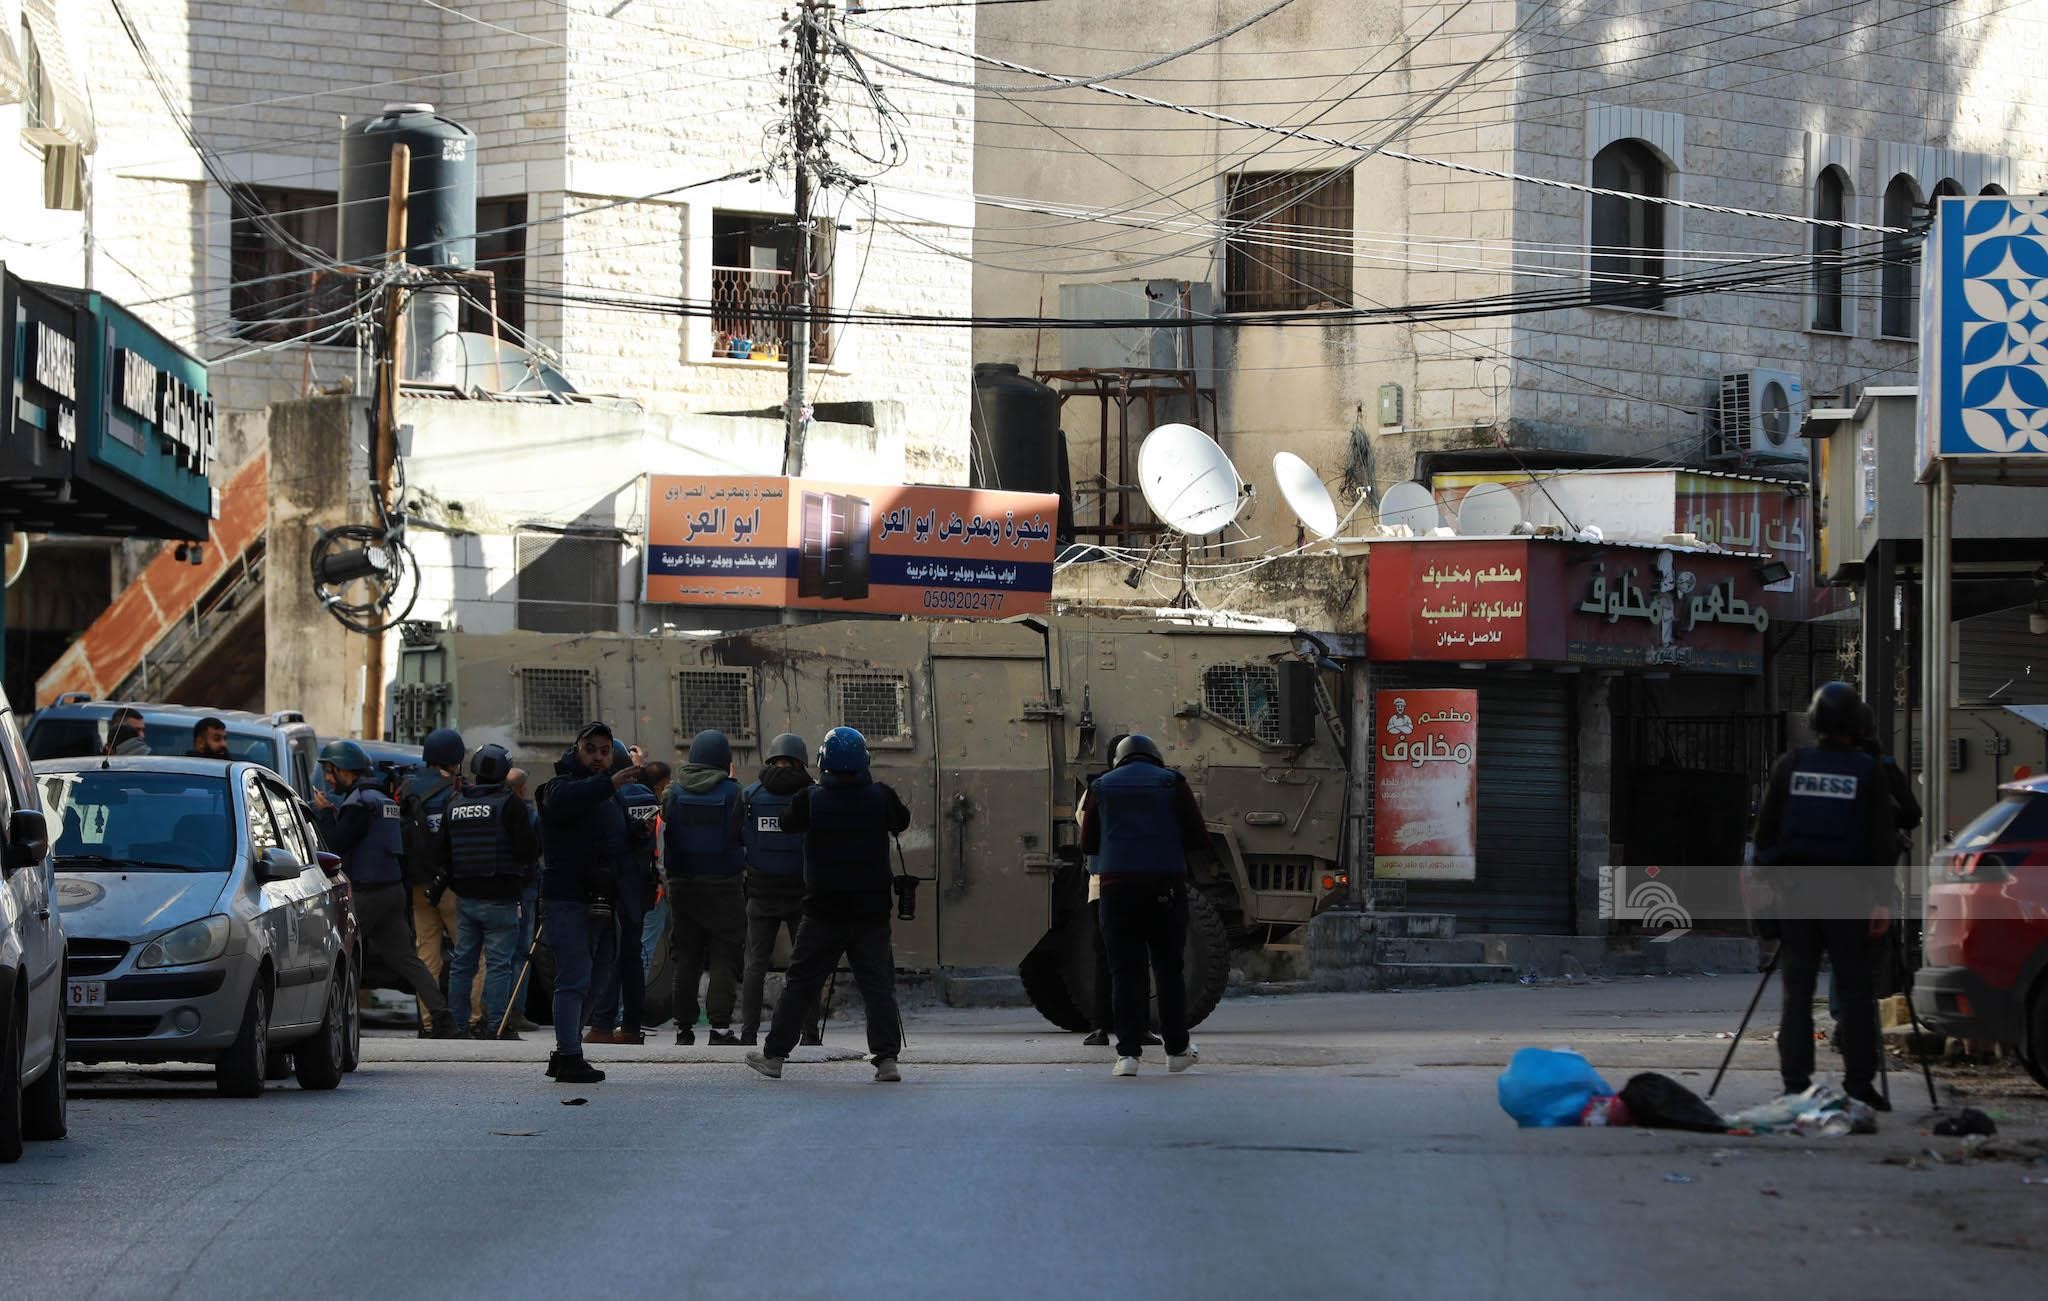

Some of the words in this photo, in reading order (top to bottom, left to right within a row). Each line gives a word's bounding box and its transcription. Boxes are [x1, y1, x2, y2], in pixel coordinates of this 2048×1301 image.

[684, 506, 727, 543] العز
[733, 508, 761, 544] ابو
[879, 506, 912, 541] العز
[913, 508, 936, 543] ابو
[938, 511, 1002, 545] ومعرض
[1004, 510, 1050, 549] منجرة
[661, 552, 683, 567] عربية
[685, 553, 706, 567] نجارة
[734, 554, 757, 568] خشب
[757, 553, 778, 569] أبواب
[906, 561, 928, 580] عربية
[928, 564, 948, 582] نجارة
[975, 565, 997, 584] خشب
[998, 566, 1016, 585] أبواب
[1421, 560, 1472, 588] مخلوف
[1475, 564, 1522, 588] مطعم
[923, 591, 1004, 612] 0599202477
[1579, 562, 1664, 624] مخلوف
[1421, 596, 1468, 624] الشعبية
[1688, 576, 1769, 633] مطعم
[1436, 631, 1466, 646] عنوان
[1468, 631, 1502, 646] للاصل
[1418, 707, 1472, 725] مطعم
[1381, 733, 1472, 768] مخلوف
[1794, 775, 1854, 796] PRESS
[451, 805, 491, 820] PRESS
